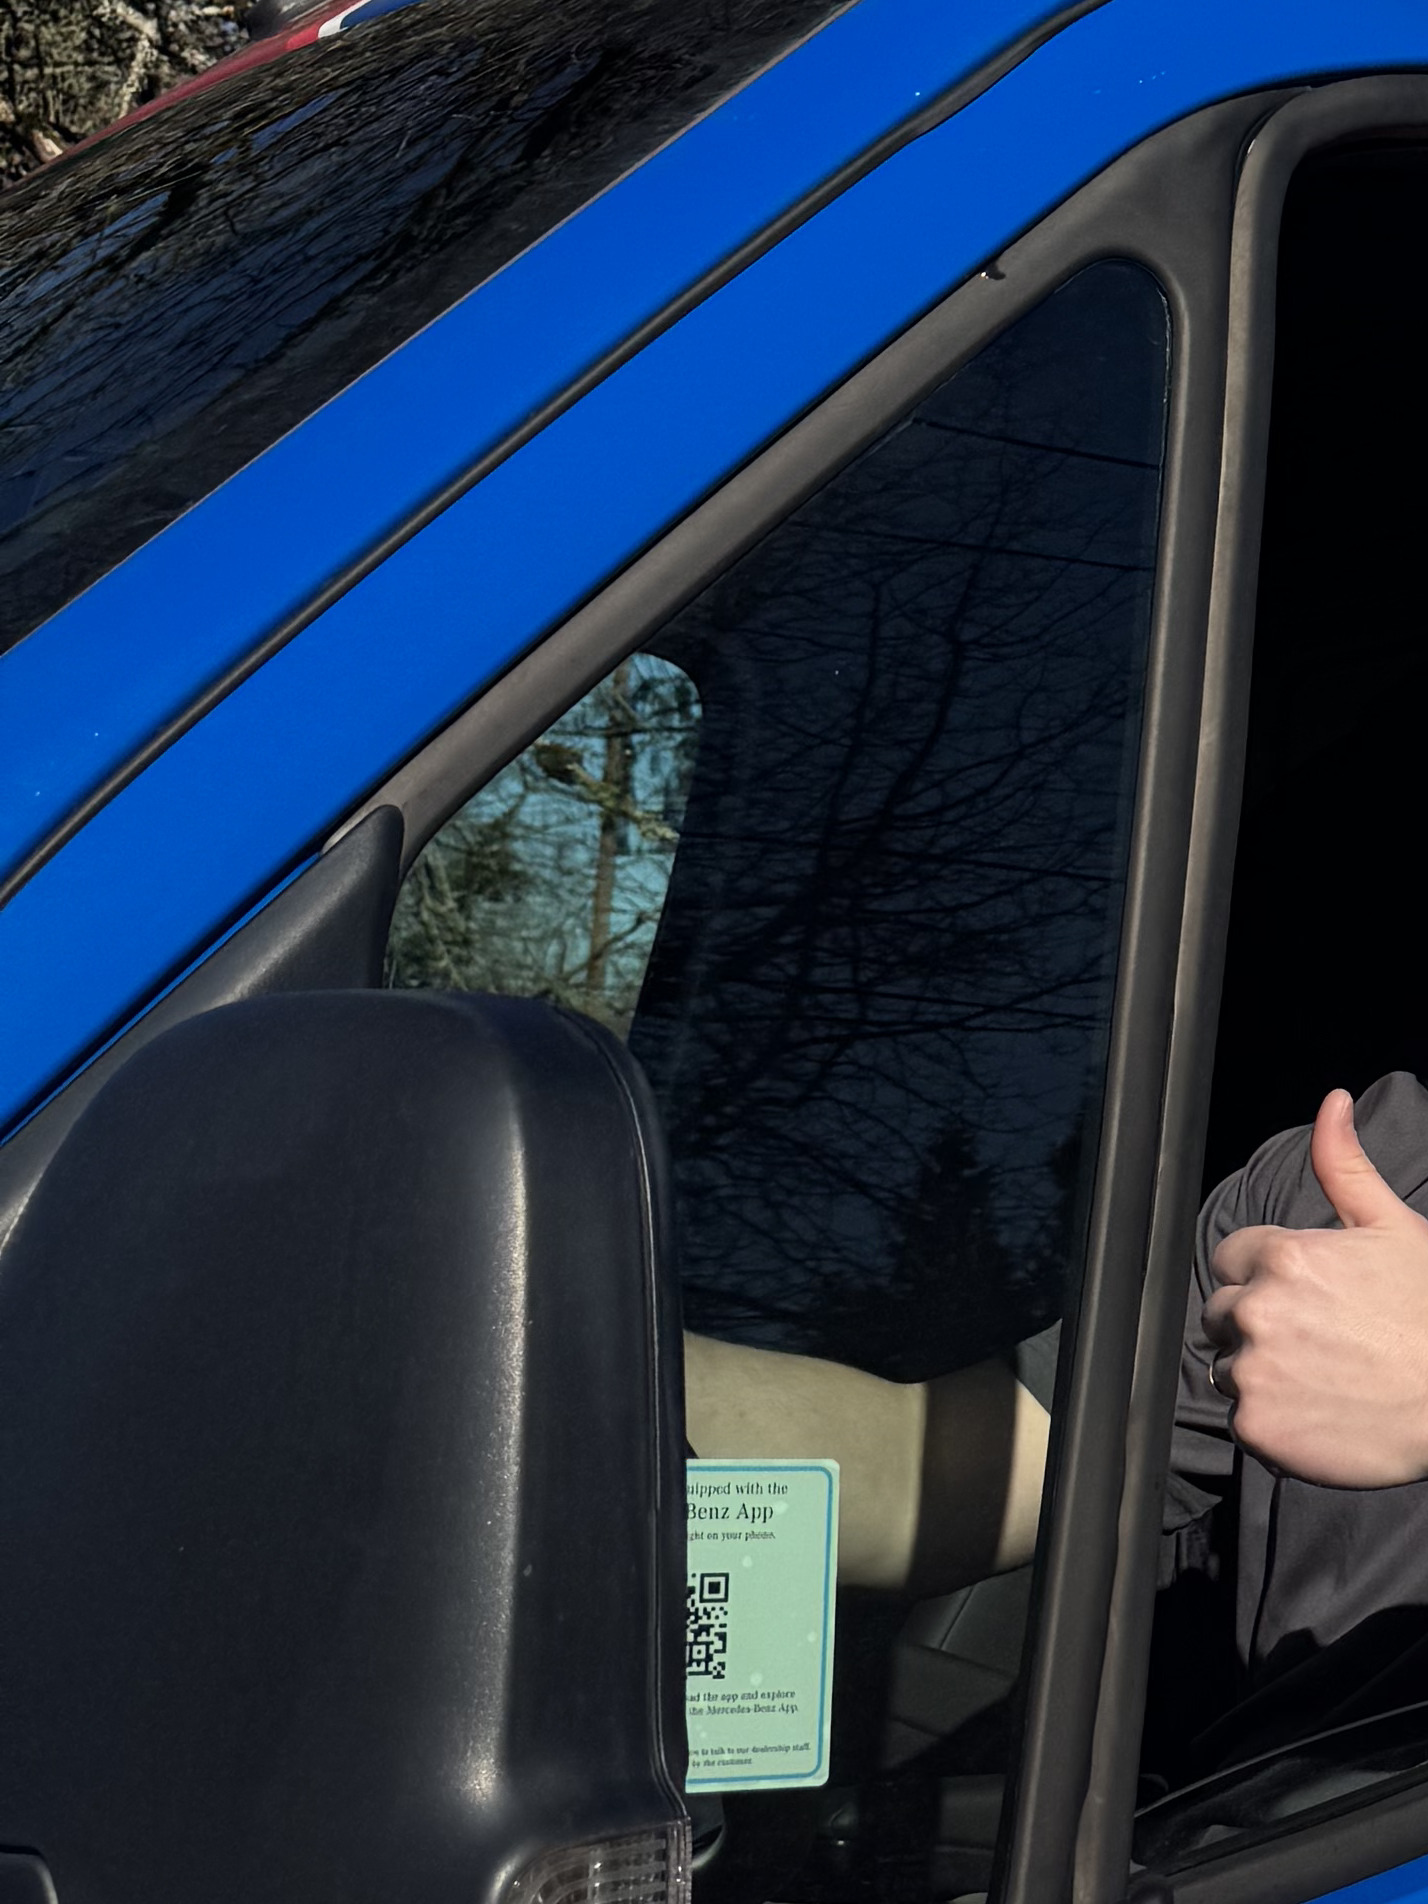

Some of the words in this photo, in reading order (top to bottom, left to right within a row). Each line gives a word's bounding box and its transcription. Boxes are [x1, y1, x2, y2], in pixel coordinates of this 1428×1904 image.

[736, 1482, 763, 1495] with
[768, 1482, 788, 1495] the
[736, 1503, 774, 1523] App
[707, 1532, 719, 1540] on
